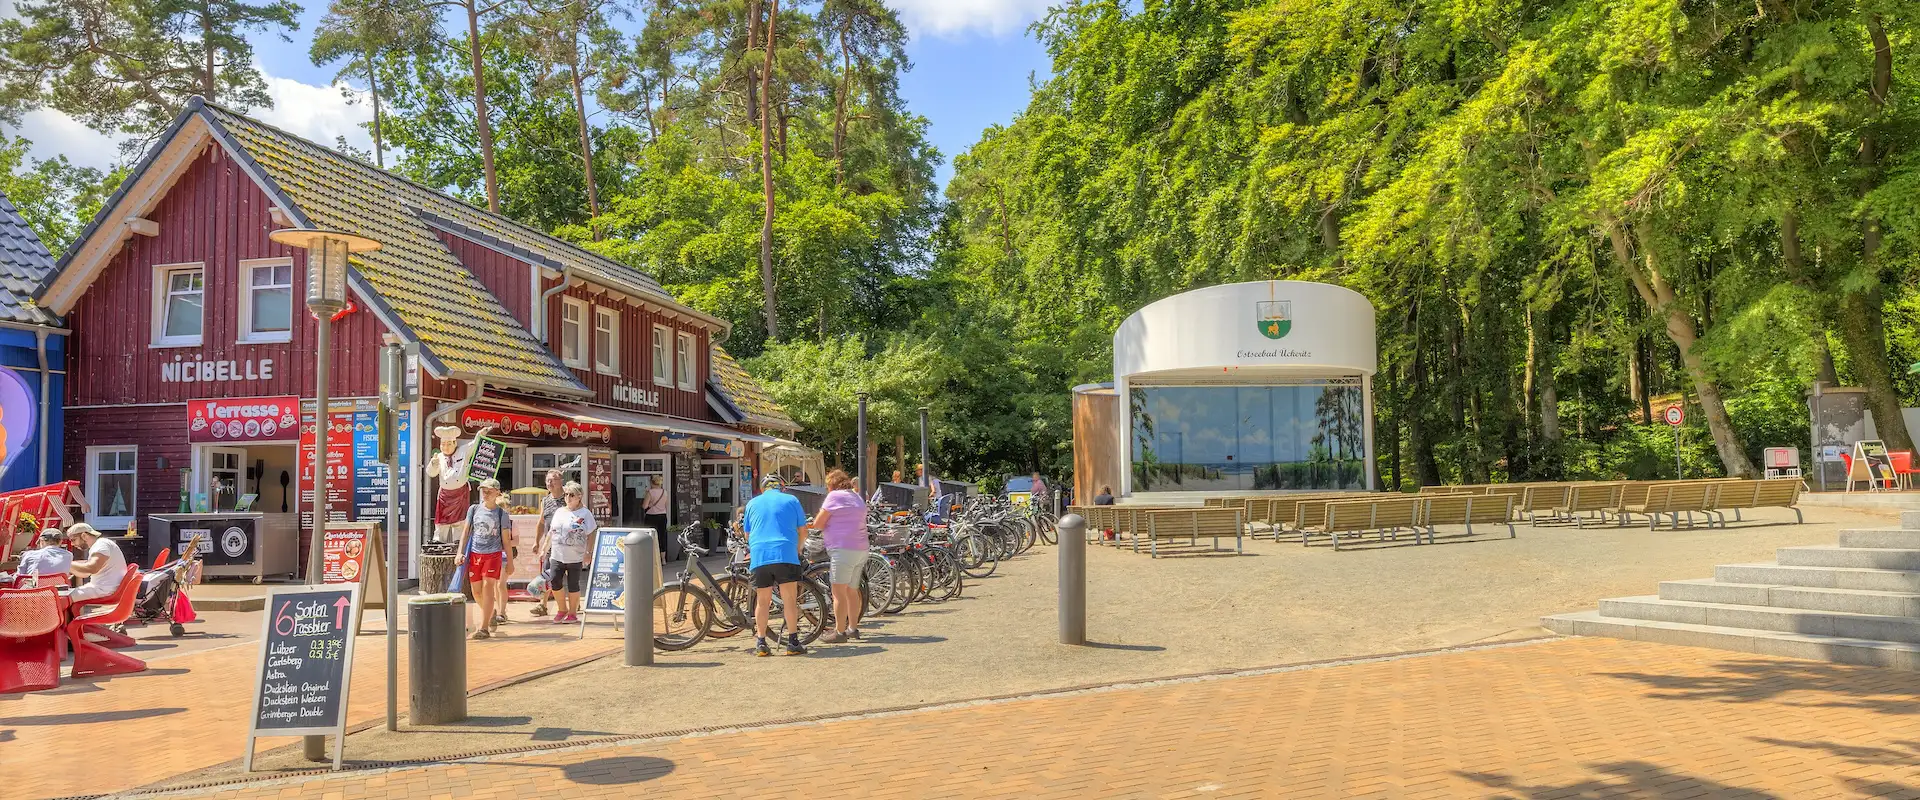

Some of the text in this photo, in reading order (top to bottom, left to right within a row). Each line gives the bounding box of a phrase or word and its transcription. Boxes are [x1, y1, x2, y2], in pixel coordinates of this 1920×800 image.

[1236, 349, 1278, 358] Ostseebad
[206, 402, 279, 419] Terrasse
[602, 535, 616, 545] HOT
[600, 546, 617, 556] DOGS
[276, 600, 328, 636] 6 Sorten
[293, 618, 331, 635] Fassbier
[268, 655, 303, 669] Carlsberg
[266, 669, 287, 680] Astra
[264, 681, 330, 696] Duckstein Original
[263, 694, 326, 707] Duckstein Weizen
[300, 706, 324, 718] Double
